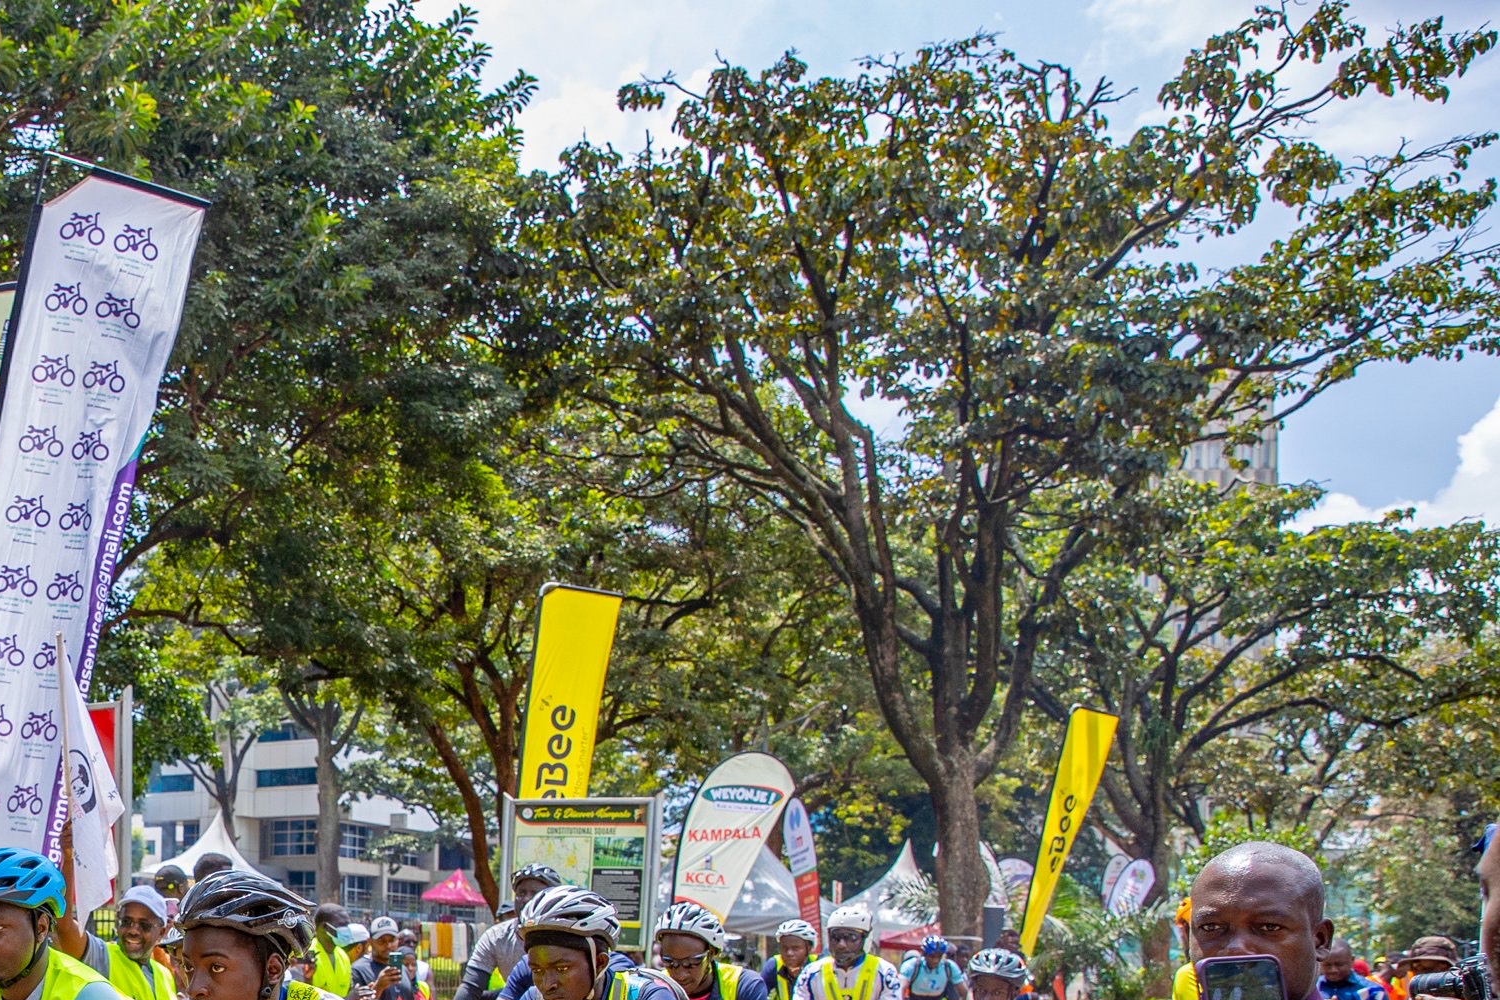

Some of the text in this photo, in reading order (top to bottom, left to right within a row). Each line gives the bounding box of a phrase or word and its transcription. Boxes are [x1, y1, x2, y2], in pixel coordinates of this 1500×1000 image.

[563, 807, 596, 819] Discover
[596, 806, 632, 820] Kampala
[546, 827, 593, 835] CONSTITUTIONAL
[688, 826, 762, 842] KAMPALA
[685, 872, 725, 886] KCCA
